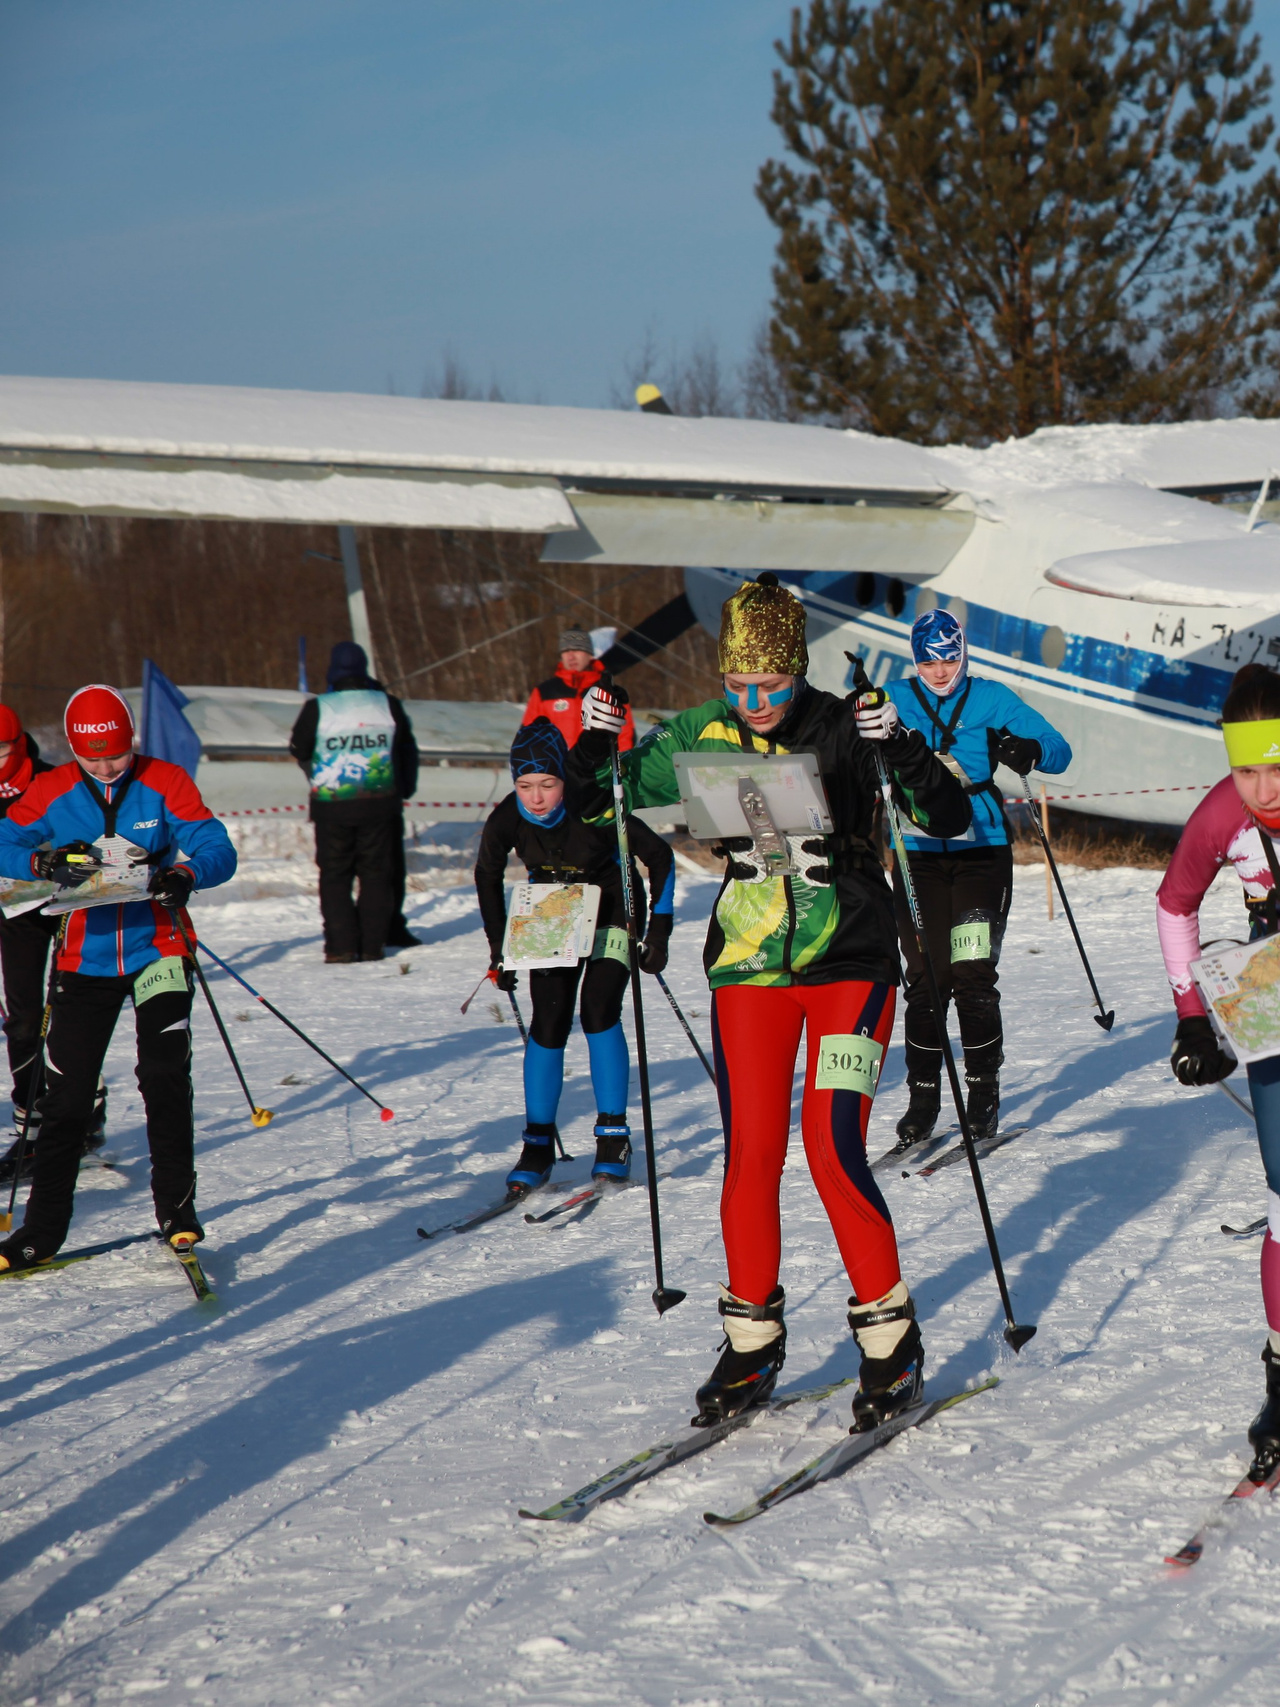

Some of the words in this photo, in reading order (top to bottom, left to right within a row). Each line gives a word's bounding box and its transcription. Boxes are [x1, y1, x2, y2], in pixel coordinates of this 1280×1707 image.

[73, 720, 119, 734] LUKOIL
[325, 733, 388, 752] СУДЬЯ
[142, 968, 175, 994] 306.1
[826, 1052, 874, 1077] 302.1
[915, 1081, 936, 1089] TISA
[724, 1305, 750, 1315] SALOMON
[866, 1310, 897, 1322] SALOMON
[572, 1457, 643, 1502] FISCHER
